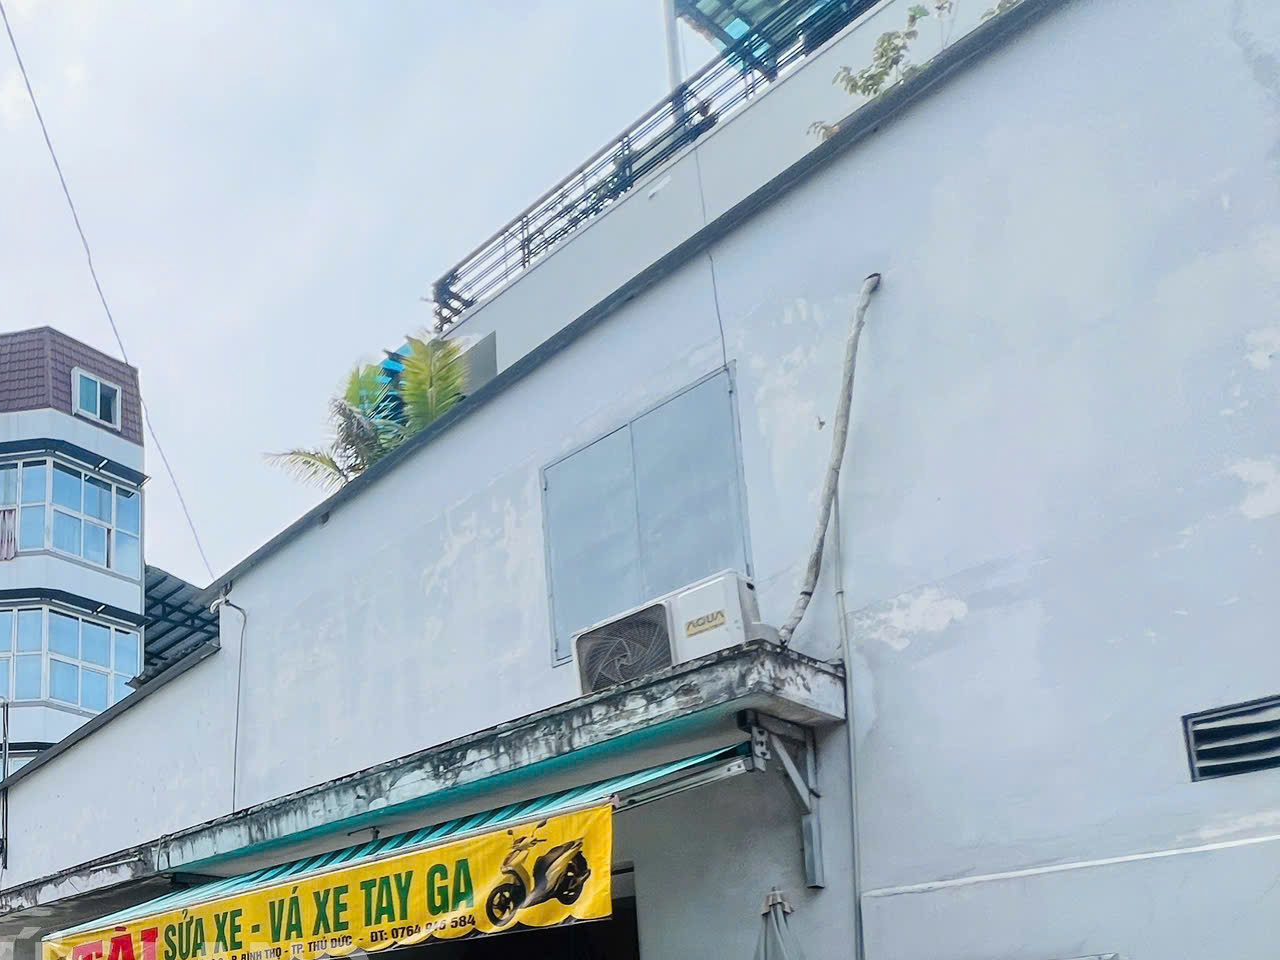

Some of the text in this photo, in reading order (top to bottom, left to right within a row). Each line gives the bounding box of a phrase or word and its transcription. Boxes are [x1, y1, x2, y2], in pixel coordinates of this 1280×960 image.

[687, 610, 725, 628] AQUA
[213, 908, 243, 952] XE
[268, 886, 303, 943] VÁ
[312, 885, 349, 936] XE
[360, 870, 414, 927] TAY
[427, 858, 475, 916] GA
[391, 924, 421, 939] 0764
[451, 914, 476, 928] 584
